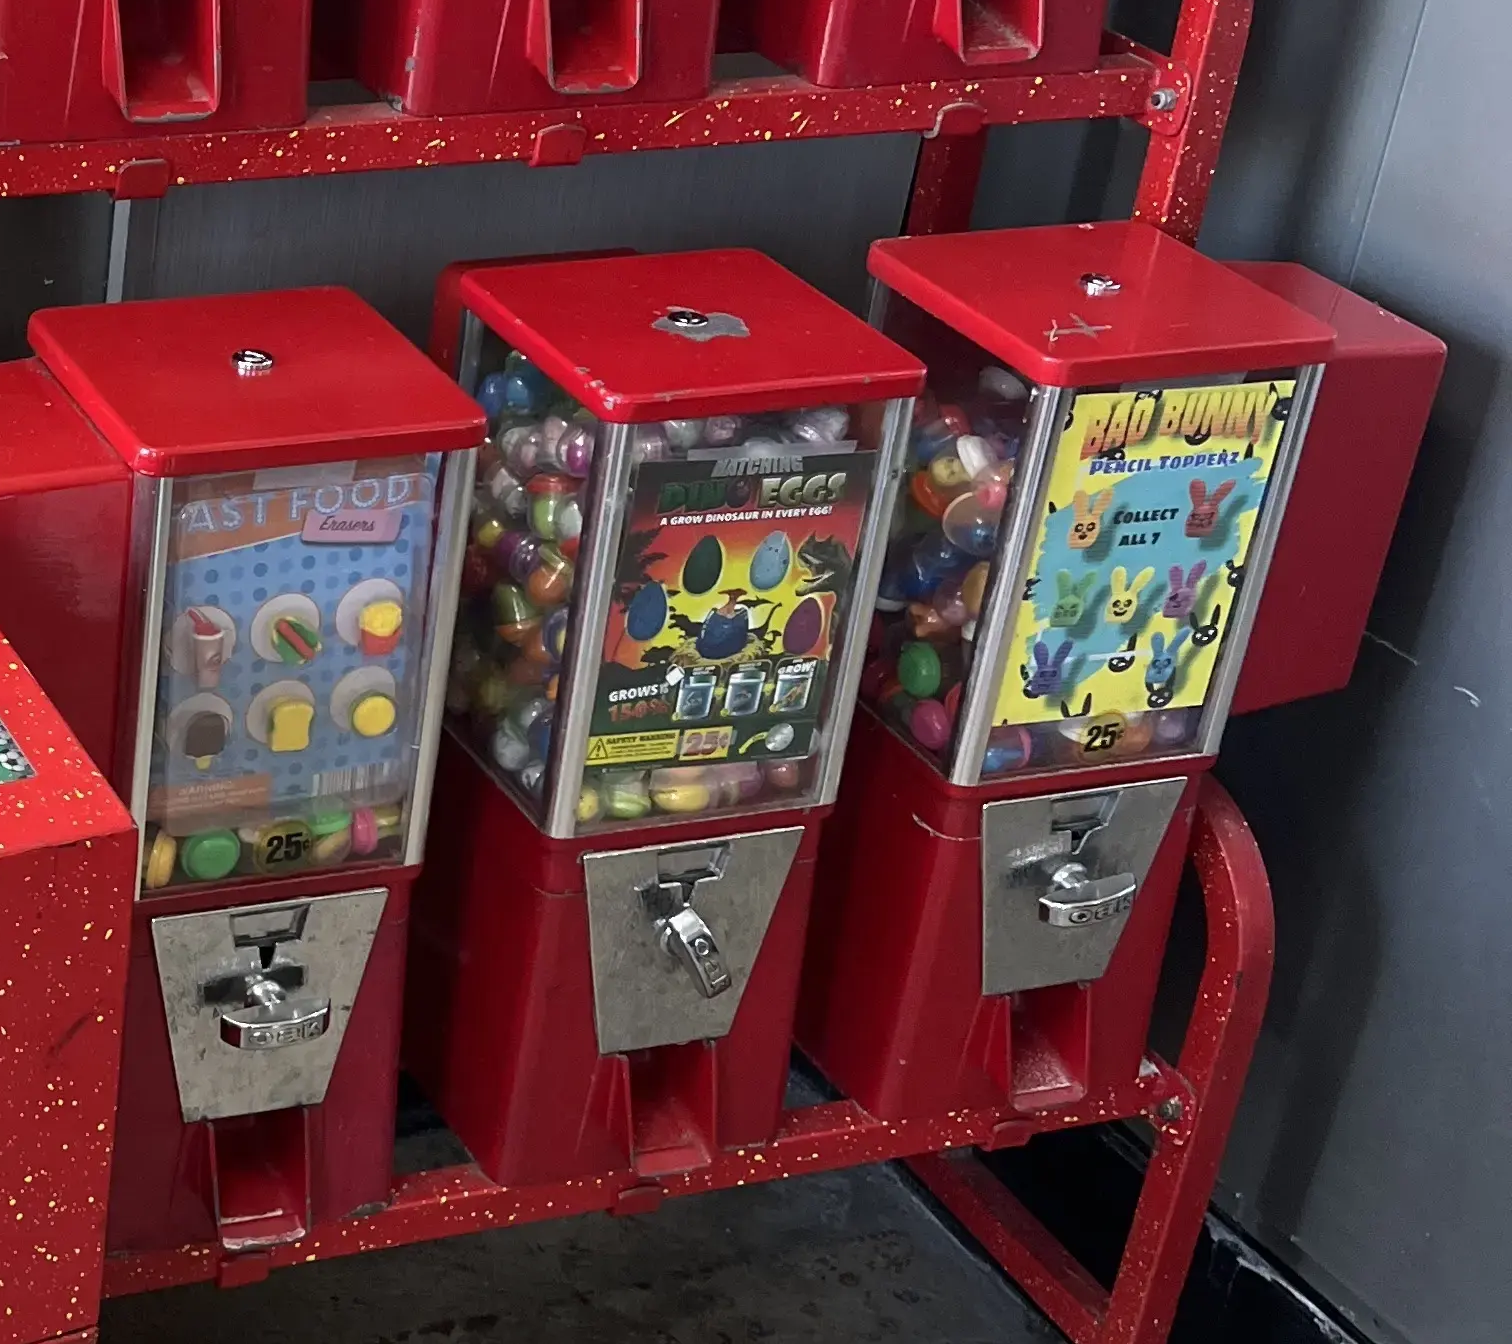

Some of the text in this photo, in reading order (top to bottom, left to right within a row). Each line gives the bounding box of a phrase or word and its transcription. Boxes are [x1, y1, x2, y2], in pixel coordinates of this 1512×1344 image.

[1079, 390, 1278, 461] BAD BUNNY
[1088, 458, 1152, 476] PENCIL
[289, 473, 413, 521] FOOD
[656, 472, 847, 514] DINO EGGS
[319, 515, 377, 533] Erasers
[660, 505, 833, 526] A GROW DINOSAUR IN EVERY EGG!
[1113, 508, 1180, 525] COLLECT
[1118, 532, 1162, 547] ALL 7
[777, 660, 818, 675] GROW!
[608, 684, 658, 703] GROWS
[682, 730, 729, 756] 25¢
